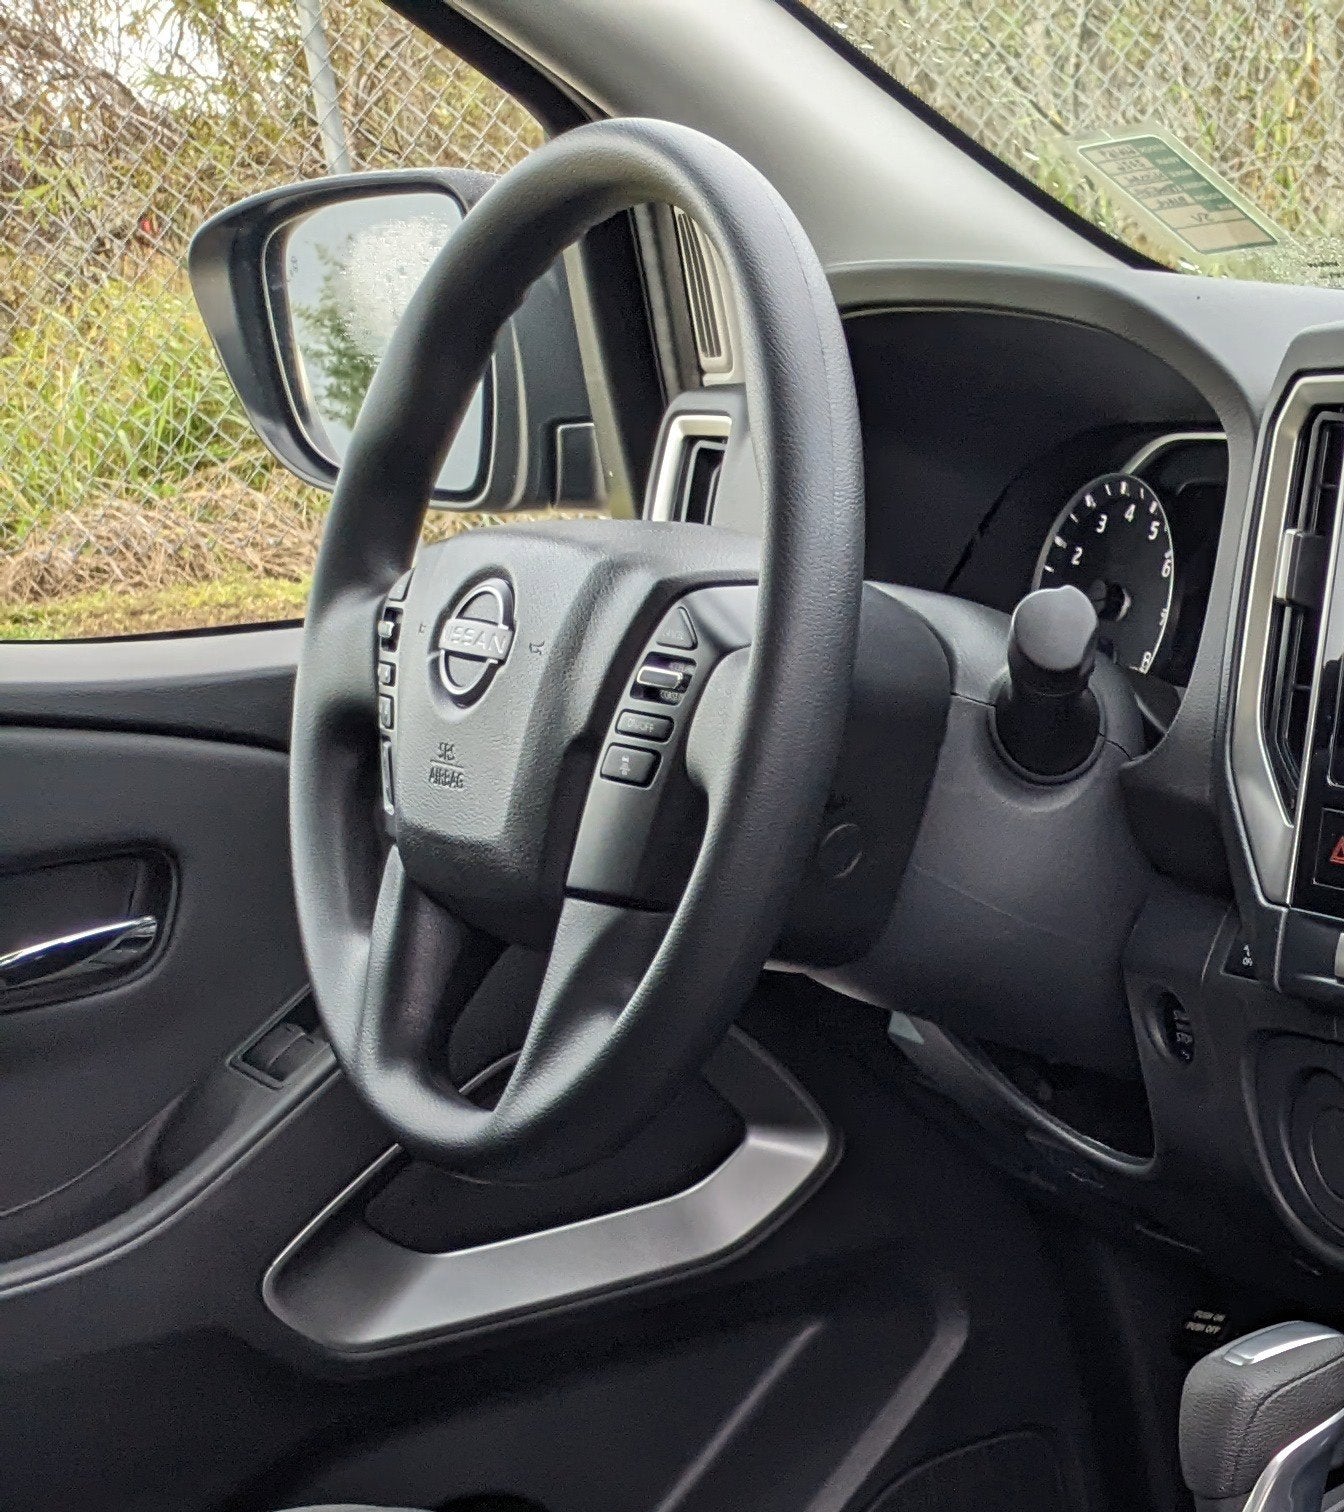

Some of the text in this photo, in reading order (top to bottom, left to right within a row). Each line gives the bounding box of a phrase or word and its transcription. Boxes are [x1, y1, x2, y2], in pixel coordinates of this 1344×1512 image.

[1124, 503, 1136, 523] 4
[1096, 514, 1108, 534] 3
[1148, 520, 1160, 541] 5
[1071, 546, 1083, 566] 2
[1161, 558, 1173, 578] 6
